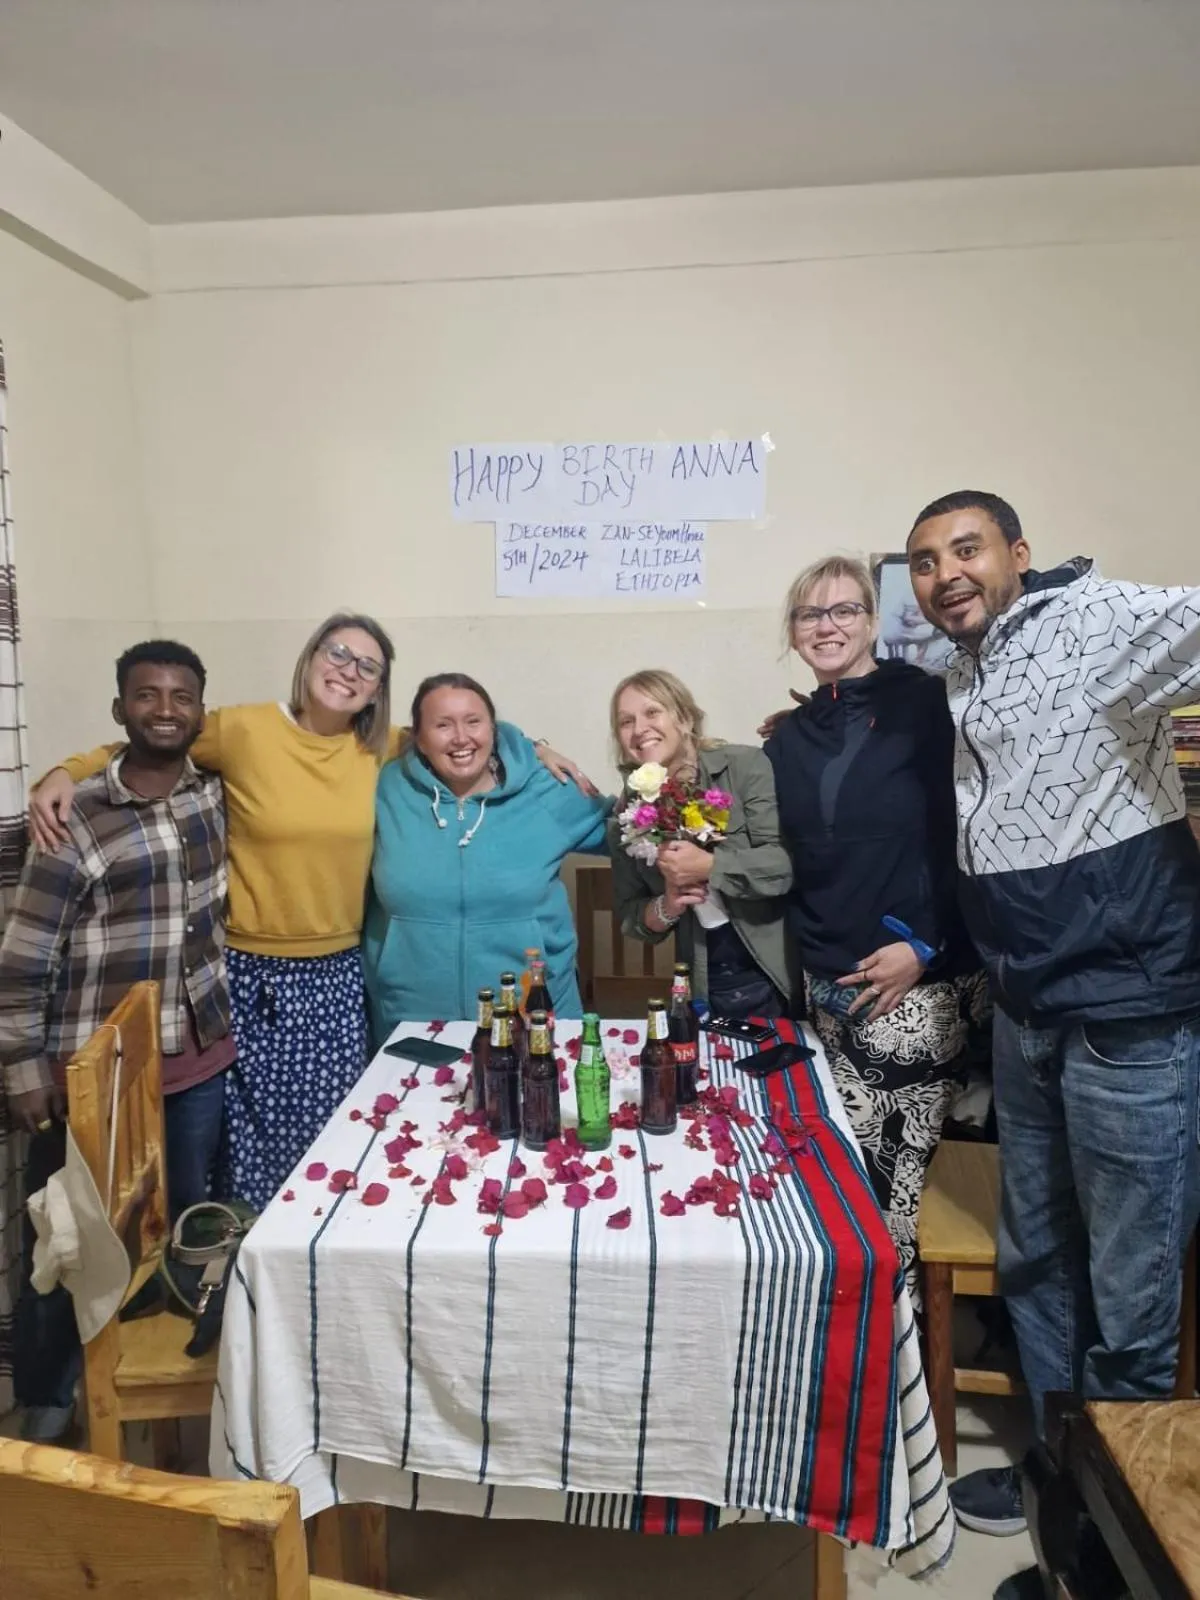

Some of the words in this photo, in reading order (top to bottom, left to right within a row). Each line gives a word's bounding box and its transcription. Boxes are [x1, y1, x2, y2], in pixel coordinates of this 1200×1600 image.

[454, 448, 543, 506] HAPPY
[562, 445, 654, 475] BIRTH
[671, 441, 759, 480] ANNA
[573, 471, 636, 508] DAY
[503, 522, 588, 543] DECEMBER
[620, 547, 702, 568] LALIBELA
[615, 570, 702, 592] ETHIOPIA
